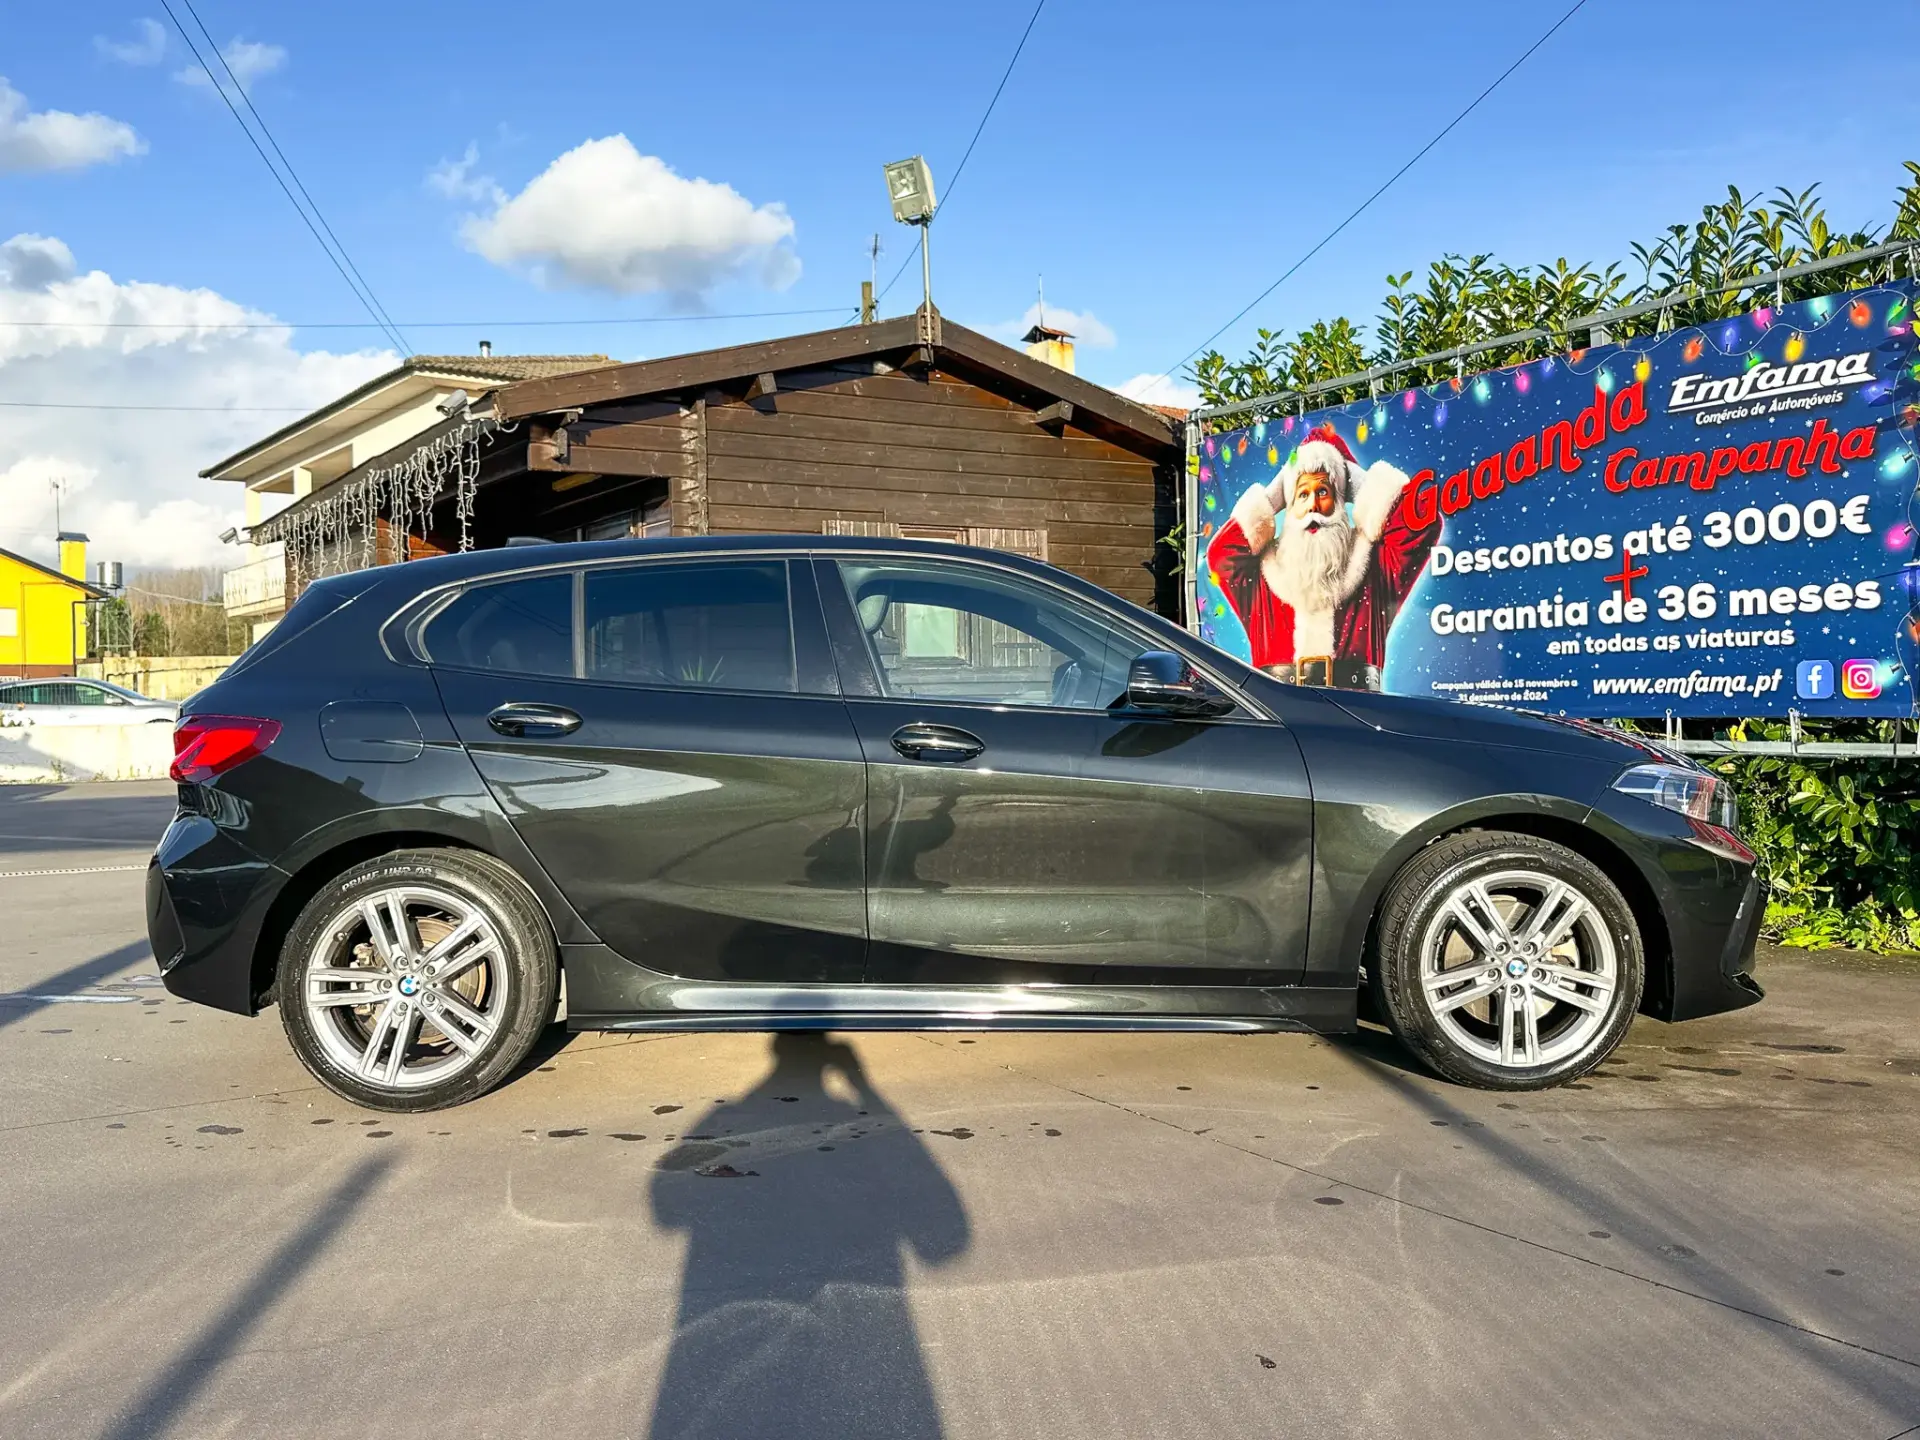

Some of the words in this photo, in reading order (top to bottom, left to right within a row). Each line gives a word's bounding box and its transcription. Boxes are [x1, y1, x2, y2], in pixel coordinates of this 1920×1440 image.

[1668, 352, 1871, 403] Emfama
[1695, 405, 1748, 425] Comércio
[1750, 402, 1766, 416] de
[1768, 390, 1844, 413] Automóveis
[1398, 380, 1648, 532] Gaaanda
[1604, 418, 1878, 491] Campanha
[1430, 533, 1614, 576] Descontos
[1622, 514, 1692, 556] até
[1702, 494, 1873, 548] 3000€
[1430, 594, 1589, 635] Garantia
[1598, 590, 1648, 625] de
[1657, 582, 1718, 621] 36
[1728, 580, 1881, 617] meses
[1548, 638, 1580, 655] em
[1584, 633, 1649, 654] todas
[1652, 632, 1681, 651] as
[1685, 628, 1796, 649] viaturas
[1431, 680, 1475, 691] Campanha
[1475, 679, 1501, 690] válida
[1501, 679, 1514, 688] de
[1514, 679, 1525, 688] 15
[1525, 678, 1570, 688] novembro
[1571, 679, 1578, 687] a
[1469, 692, 1510, 702] dezembro
[1510, 691, 1522, 701] de
[1523, 690, 1548, 701] 2024
[1592, 668, 1784, 699] www.emfama.pt
